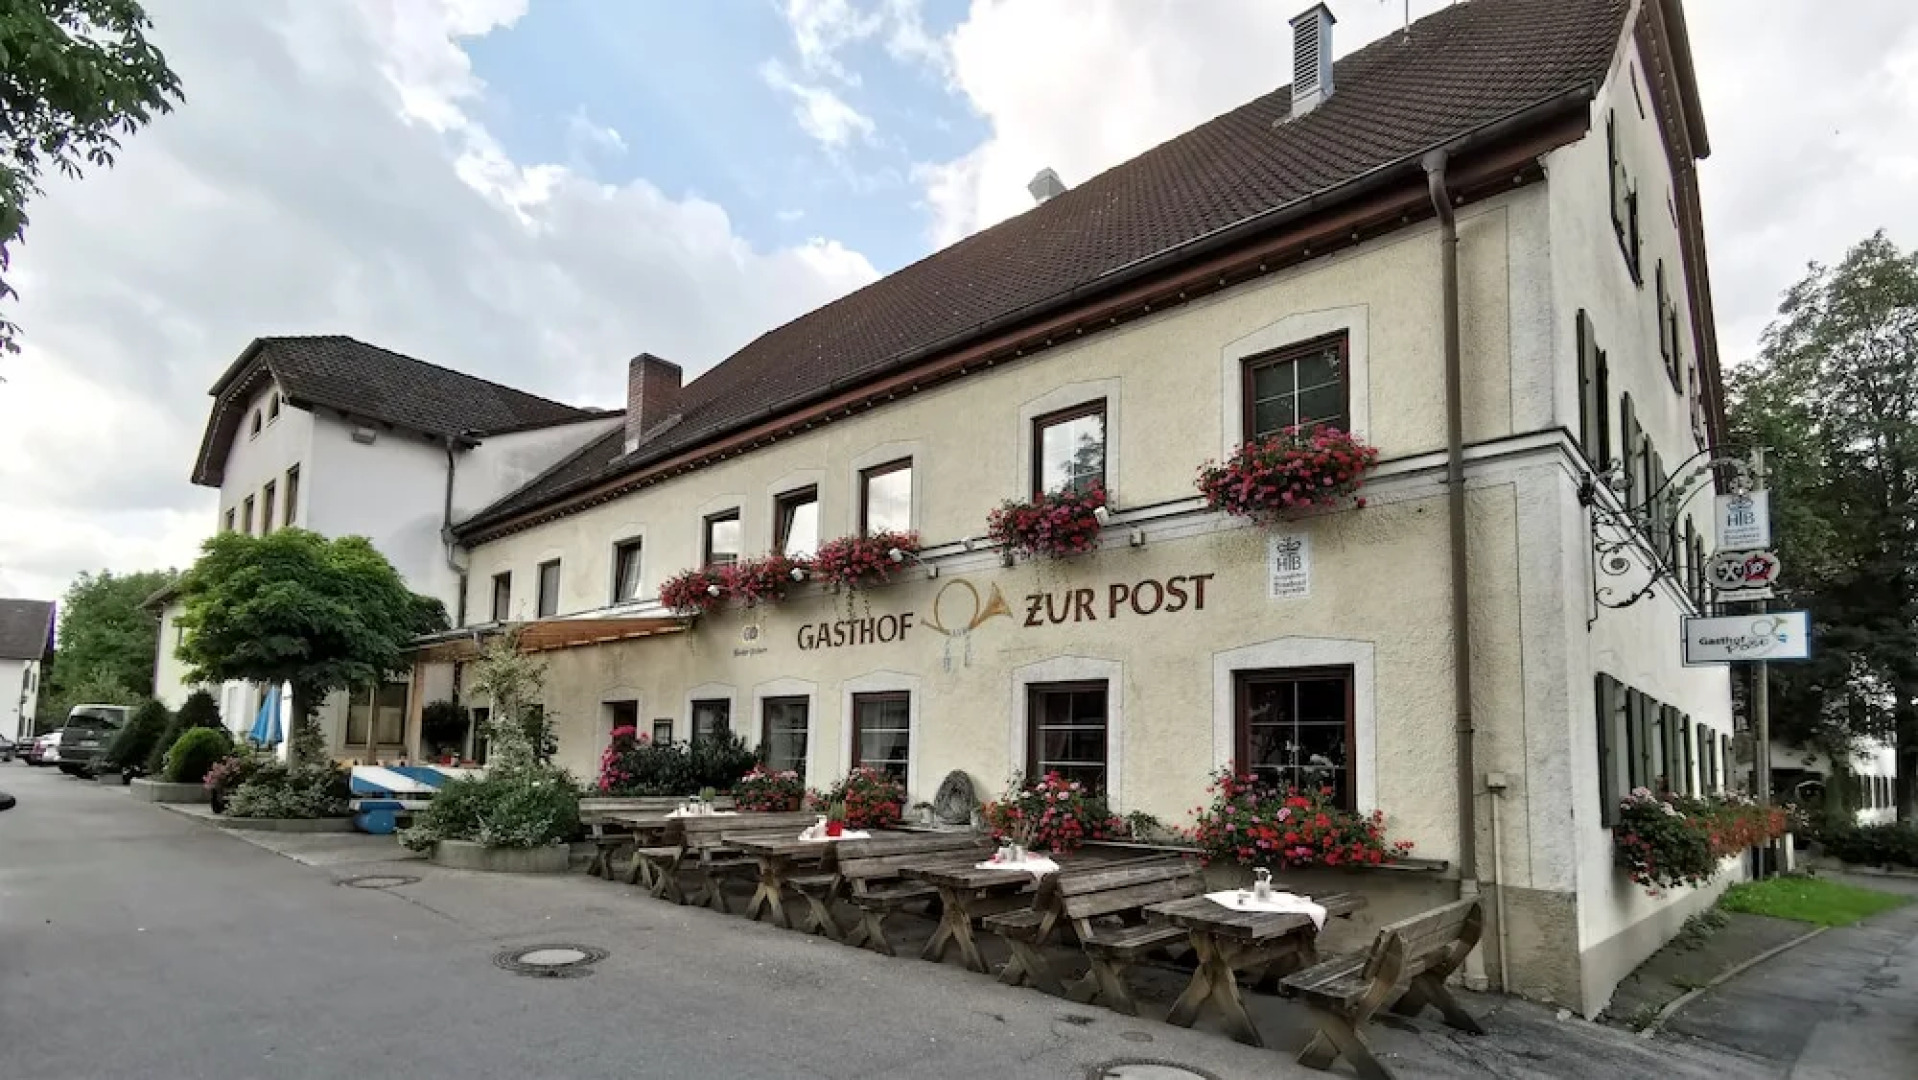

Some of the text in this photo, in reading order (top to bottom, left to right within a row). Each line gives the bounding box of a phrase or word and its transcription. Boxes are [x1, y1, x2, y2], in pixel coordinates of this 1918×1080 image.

[1276, 553, 1302, 572] HTB
[797, 573, 1215, 651] GASTHOF ZUR POST
[1698, 635, 1746, 646] Gasthof
